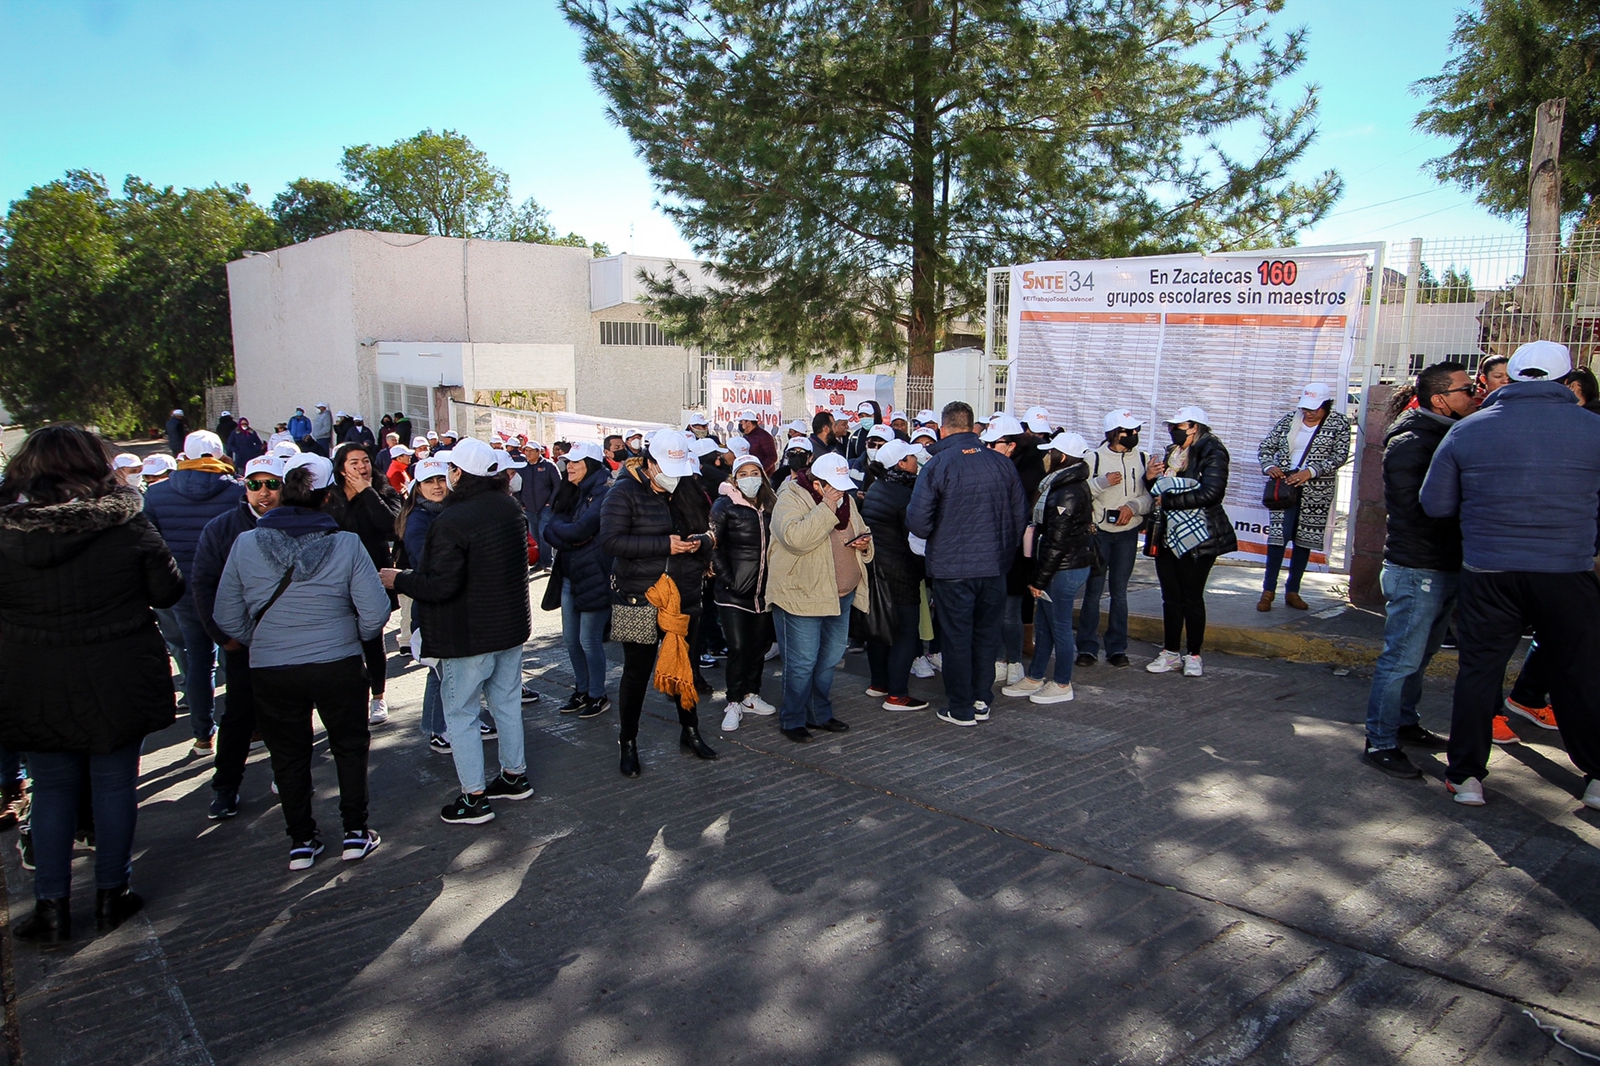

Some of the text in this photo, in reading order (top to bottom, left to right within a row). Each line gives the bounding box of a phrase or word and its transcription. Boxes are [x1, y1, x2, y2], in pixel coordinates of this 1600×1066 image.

[1023, 271, 1095, 291] SNTE 34
[1150, 260, 1297, 286] En Zacatecas 160
[1107, 288, 1347, 307] grupos escolares sin maestros
[813, 375, 858, 391] Escuelas
[722, 388, 772, 405] DSICAMM
[829, 391, 845, 406] sin
